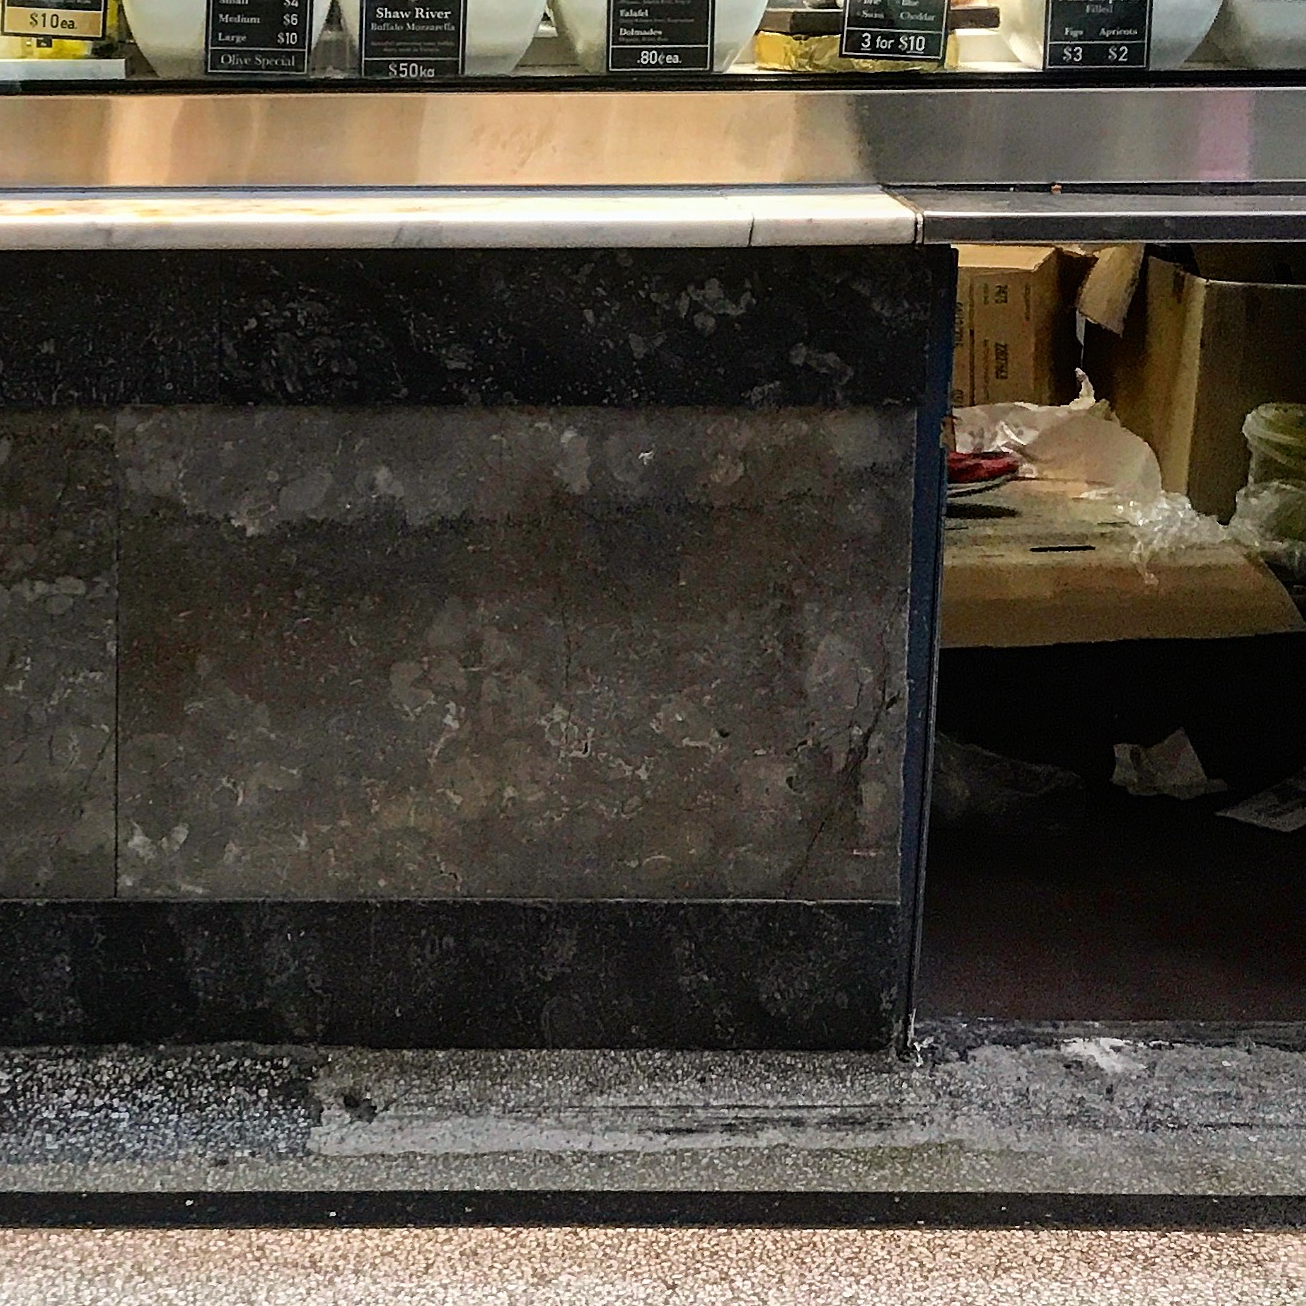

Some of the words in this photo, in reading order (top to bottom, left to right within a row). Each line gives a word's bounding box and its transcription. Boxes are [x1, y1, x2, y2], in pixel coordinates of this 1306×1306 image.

[376, 7, 411, 19] Shaw
[415, 7, 451, 19] River
[619, 9, 649, 17] Falafel
[218, 13, 261, 25] Medium
[283, 13, 298, 26] $6
[371, 22, 403, 31] Buffalo
[619, 27, 663, 36] Dolmades
[1064, 26, 1083, 37] Figs
[1099, 26, 1138, 38] Apricots
[218, 32, 247, 45] Large
[277, 32, 298, 45] $10
[861, 33, 871, 48] 3
[875, 35, 894, 49] for
[898, 35, 926, 52] $10
[1063, 46, 1083, 63] $3
[1108, 46, 1128, 63] $2
[220, 54, 252, 68] Olive
[254, 54, 296, 69] Special
